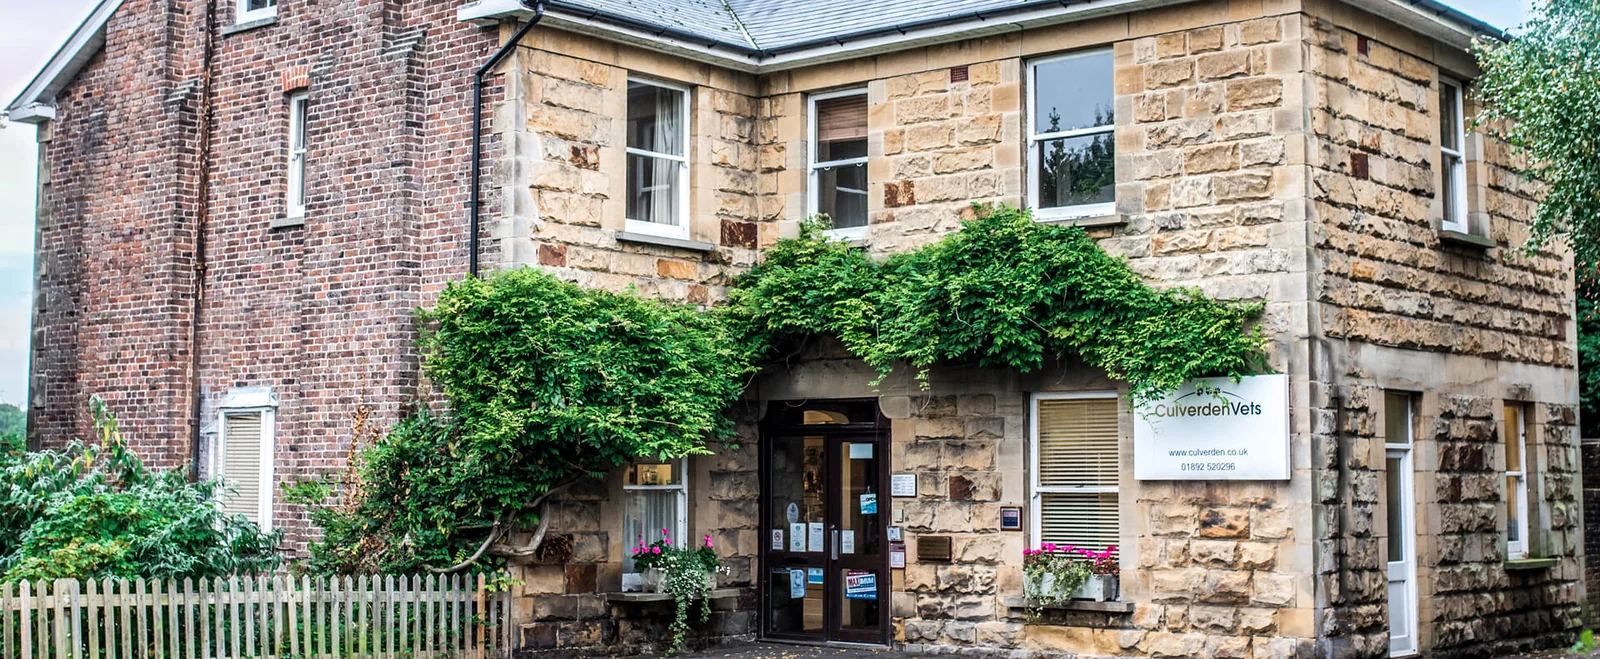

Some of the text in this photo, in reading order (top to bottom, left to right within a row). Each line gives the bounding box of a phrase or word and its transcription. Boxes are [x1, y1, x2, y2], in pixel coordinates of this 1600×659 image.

[1168, 447, 1249, 457] www.culverden.co.uk
[1181, 462, 1236, 471] 01892 520296
